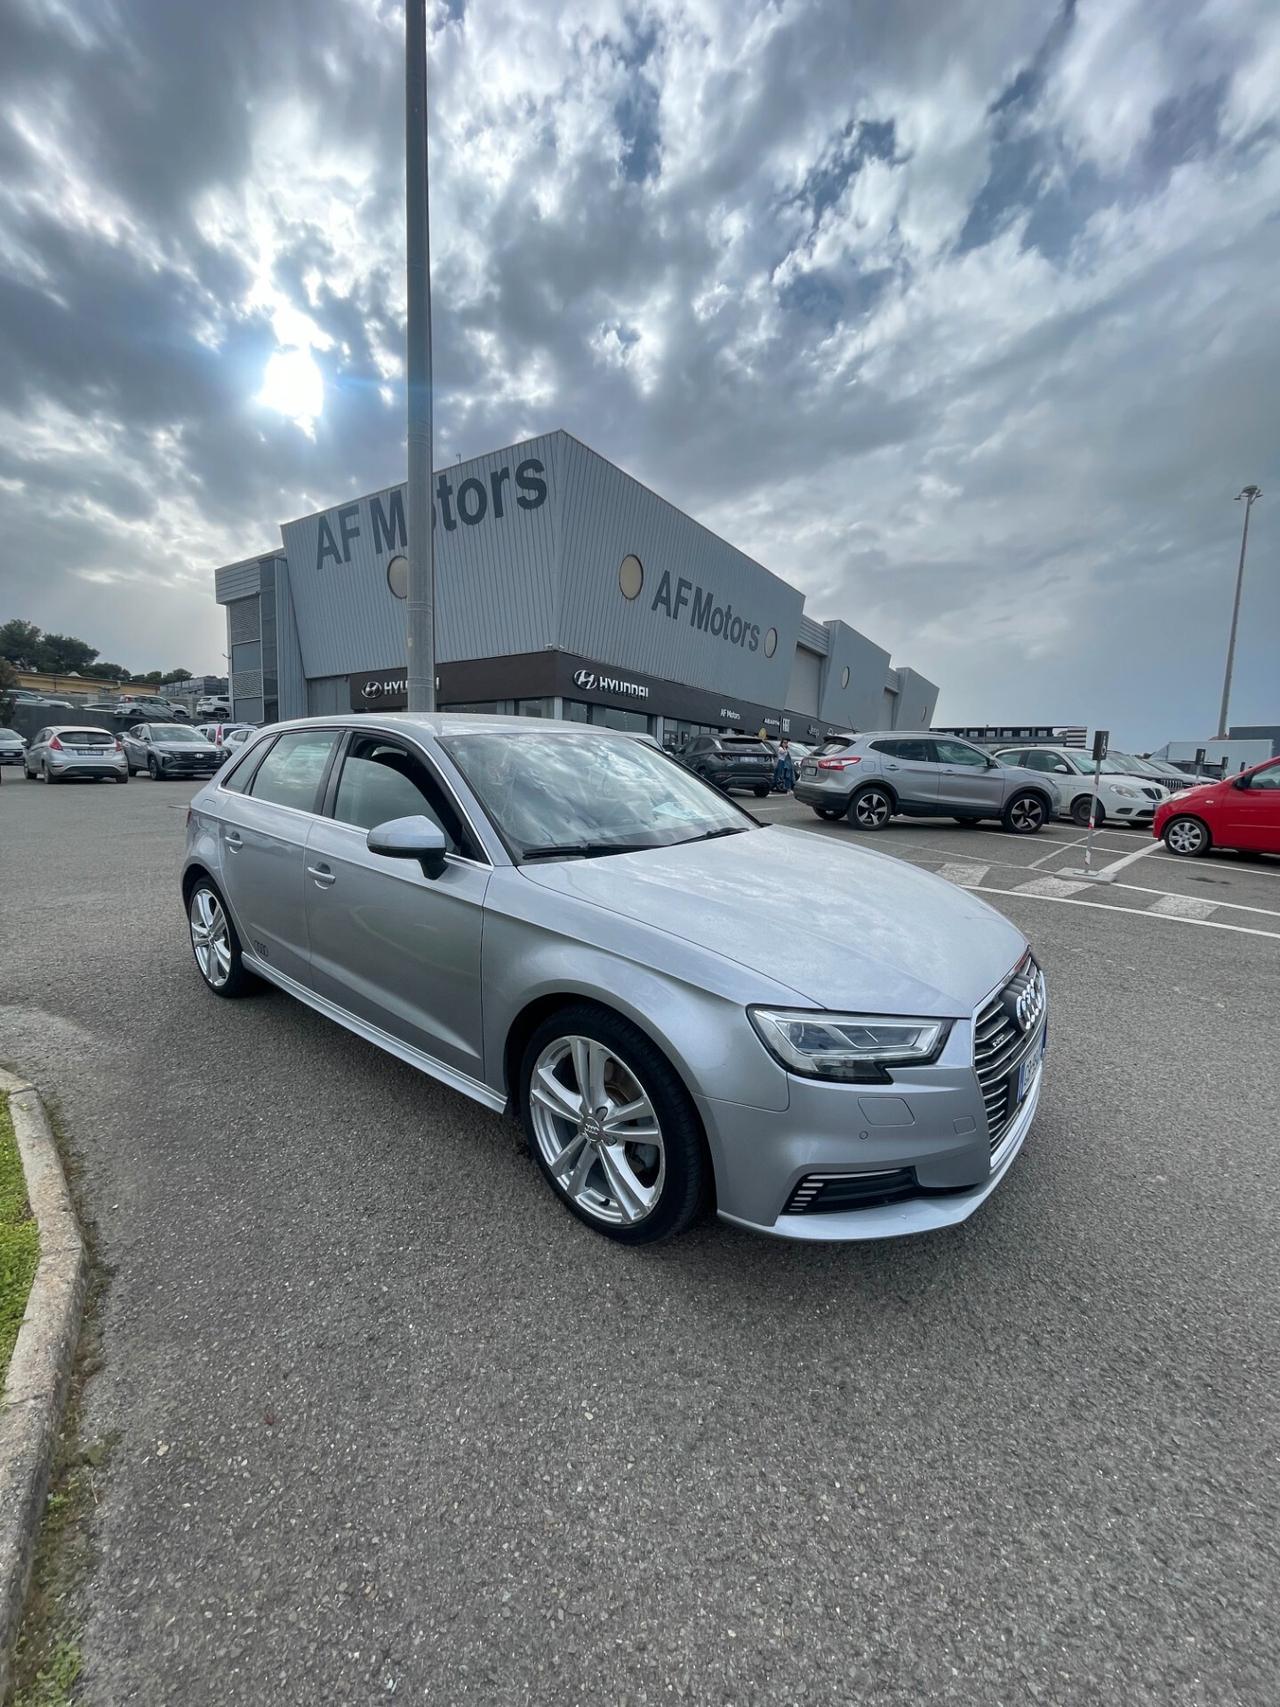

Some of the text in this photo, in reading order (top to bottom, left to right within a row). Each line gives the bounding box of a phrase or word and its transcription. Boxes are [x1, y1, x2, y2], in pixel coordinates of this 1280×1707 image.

[369, 458, 547, 555] Mtors
[384, 677, 439, 695] HYUI
[600, 676, 649, 697] HYUNDAI
